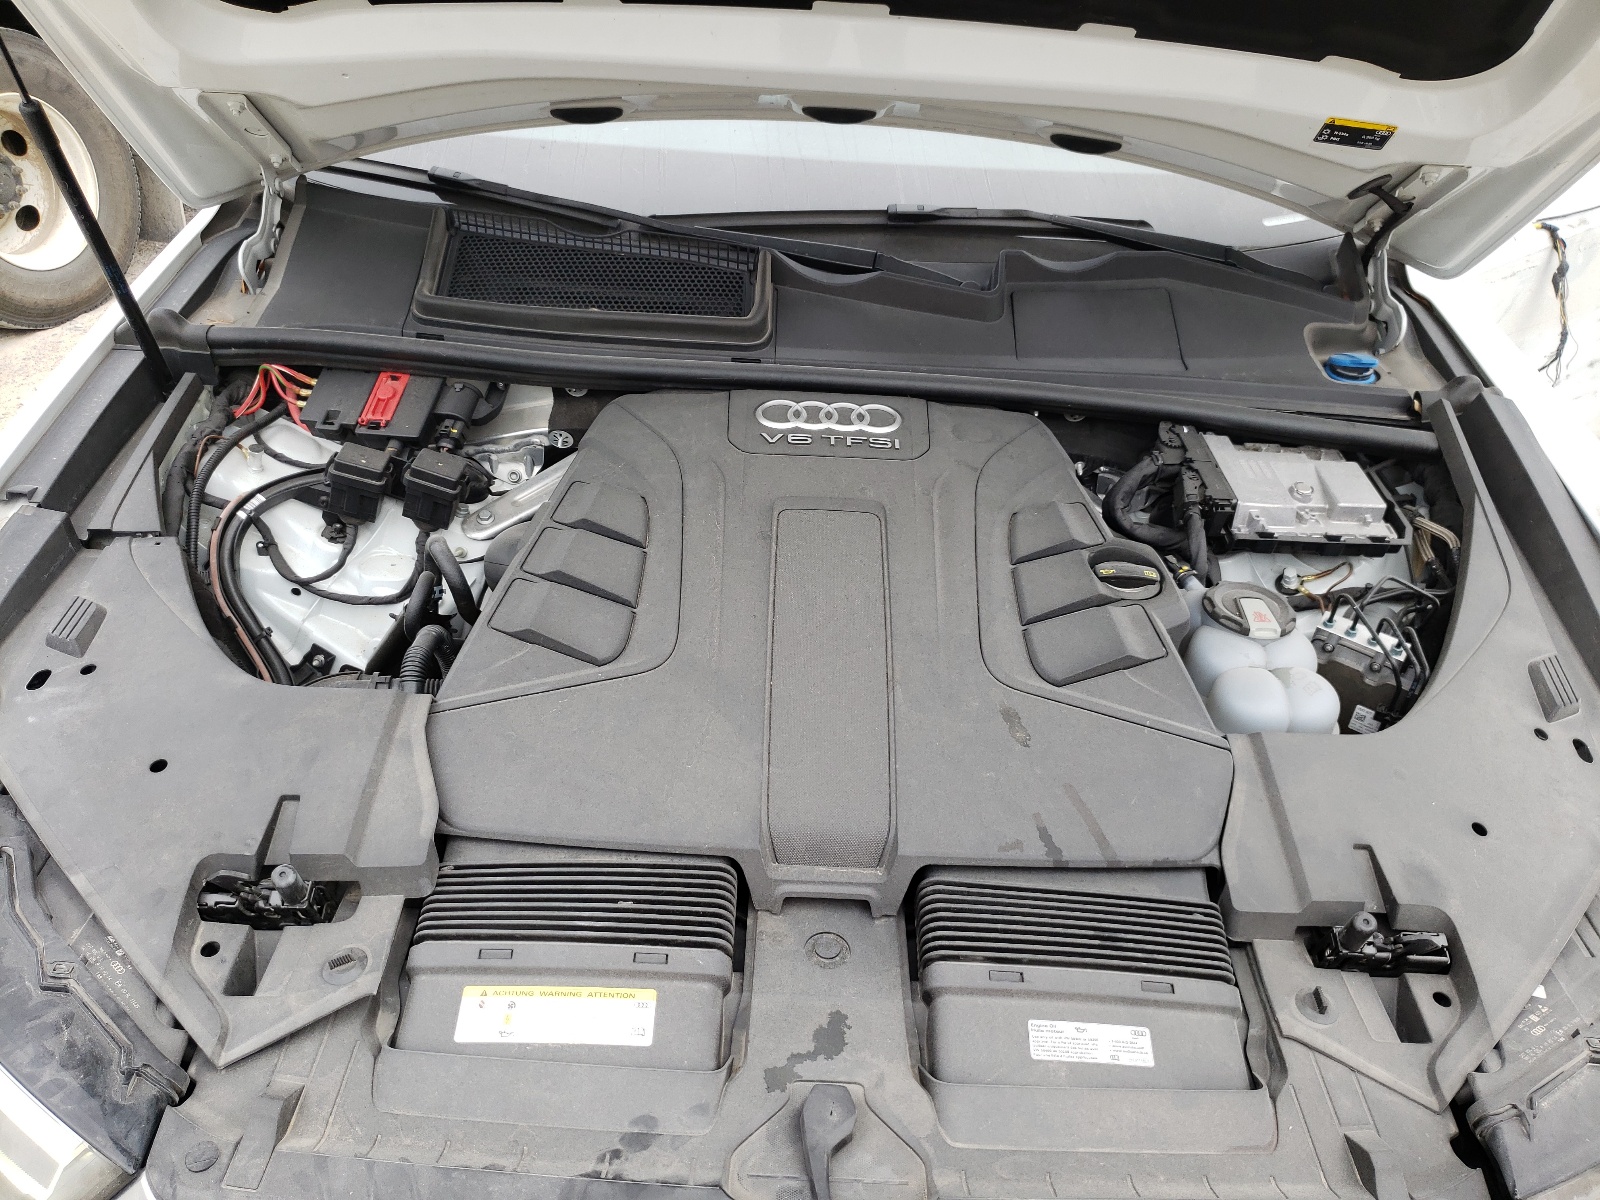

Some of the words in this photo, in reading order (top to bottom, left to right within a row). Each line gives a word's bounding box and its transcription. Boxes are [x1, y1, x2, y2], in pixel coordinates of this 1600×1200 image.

[760, 432, 813, 446] V6
[822, 434, 900, 450] TFSI
[587, 991, 636, 999] ATTENTION
